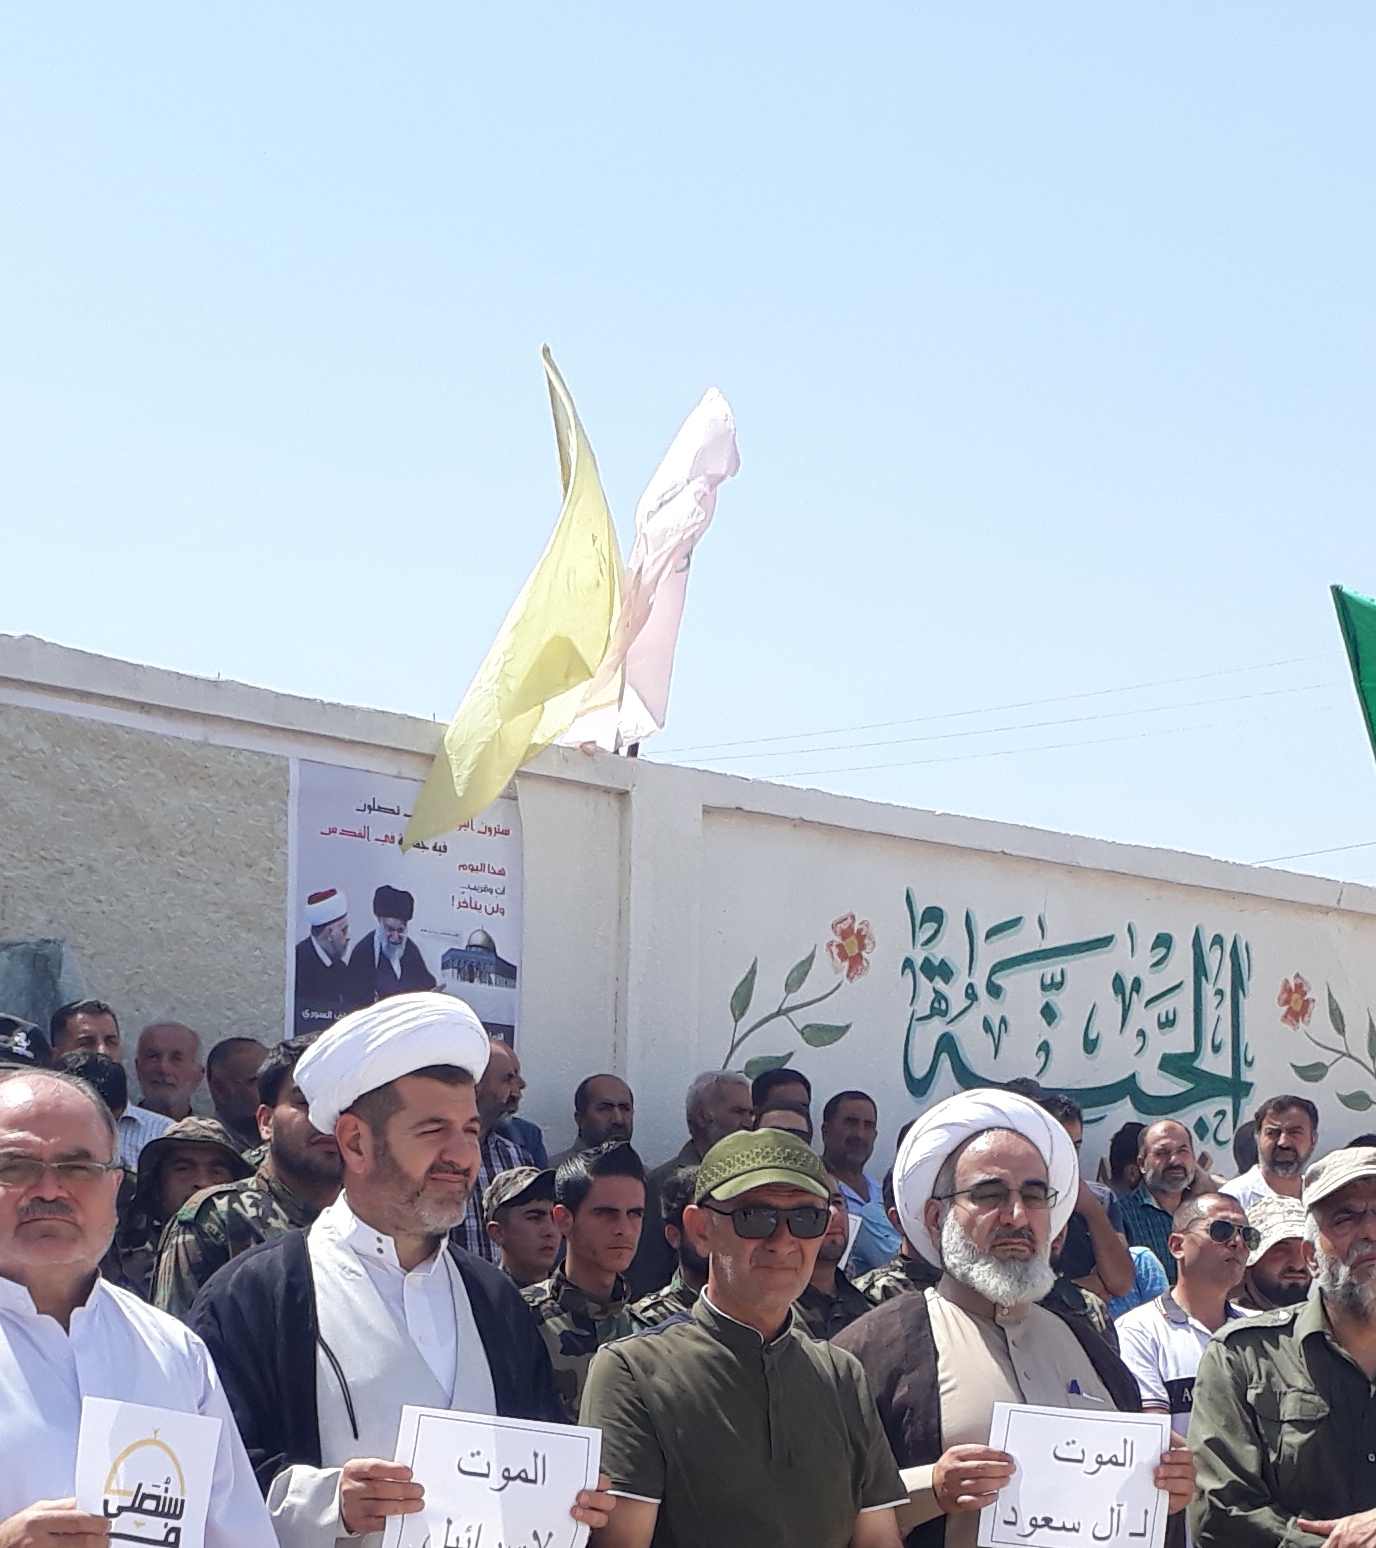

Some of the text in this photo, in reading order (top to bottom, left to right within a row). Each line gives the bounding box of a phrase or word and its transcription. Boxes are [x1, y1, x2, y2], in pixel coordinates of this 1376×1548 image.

[457, 1448, 547, 1492] الموت
[1052, 1437, 1135, 1476] الموت
[1002, 1506, 1081, 1539] سعود
[1091, 1503, 1124, 1542] آل
